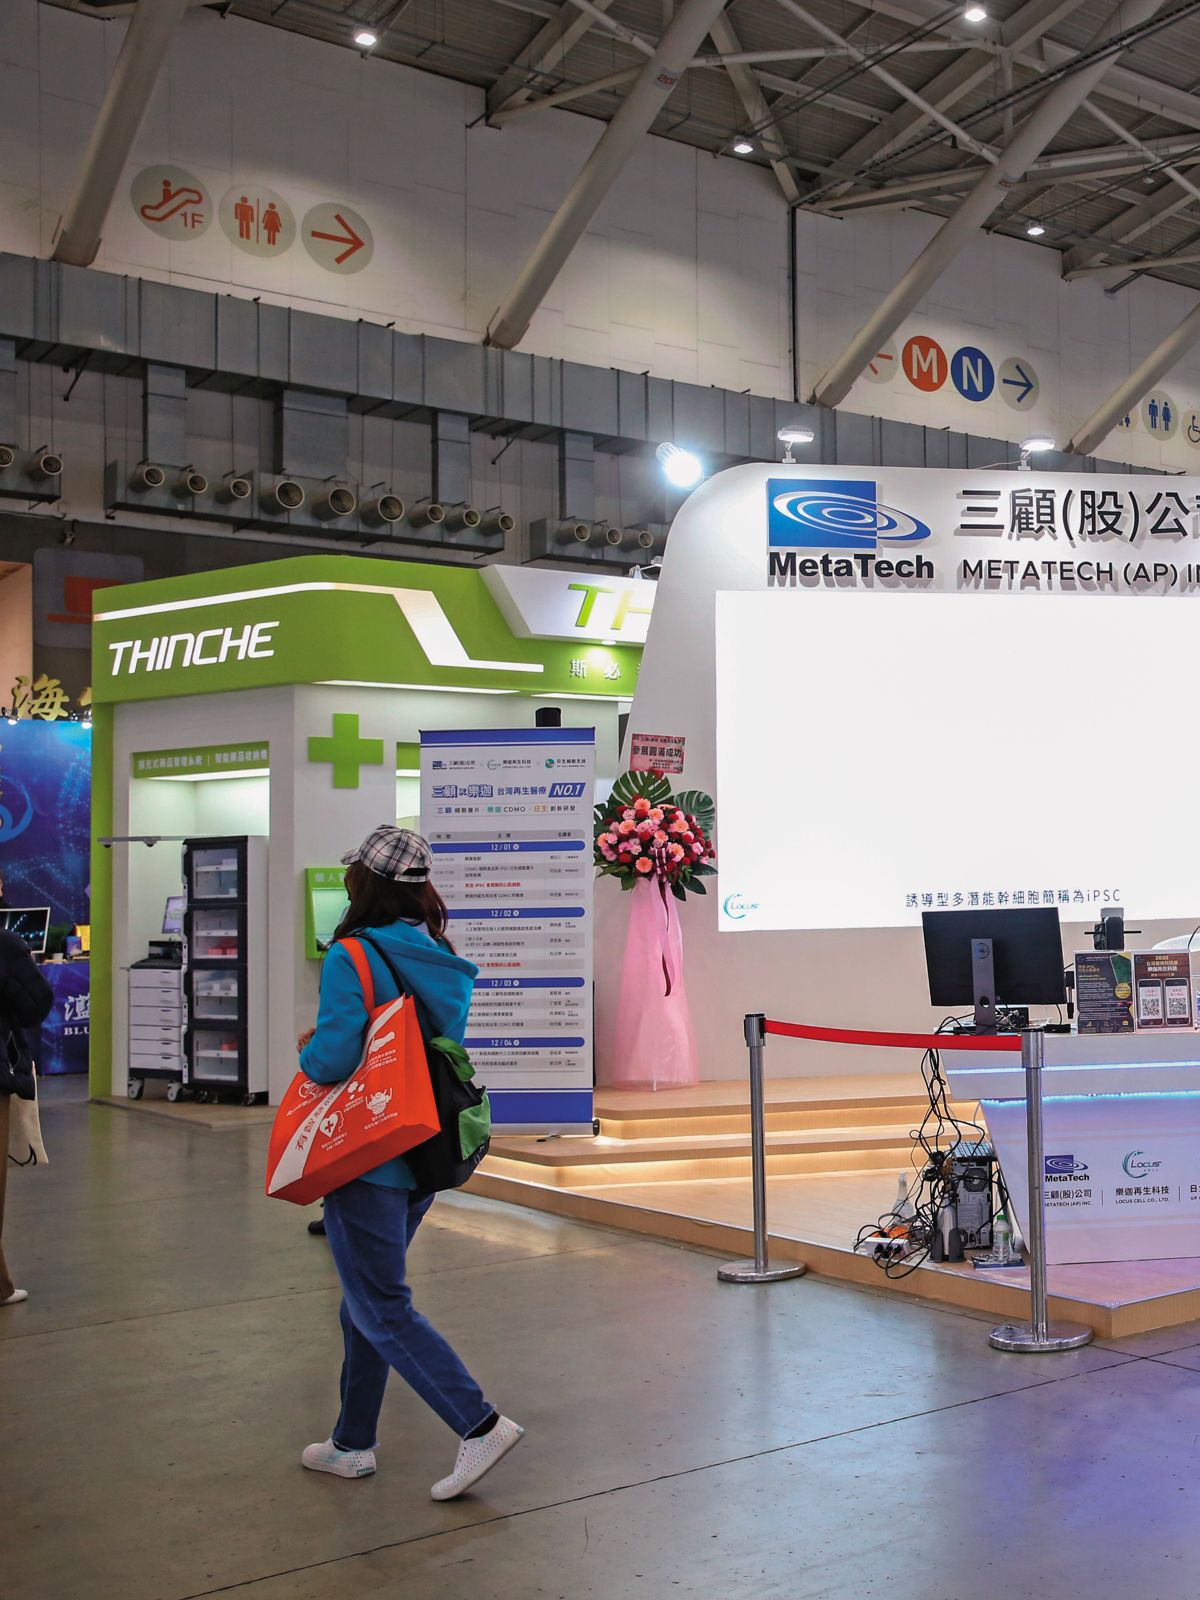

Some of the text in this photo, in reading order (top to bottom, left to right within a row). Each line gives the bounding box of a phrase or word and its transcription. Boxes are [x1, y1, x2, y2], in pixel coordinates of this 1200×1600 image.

[180, 210, 204, 230] 1F
[911, 343, 984, 394] M N
[768, 551, 935, 580] MetaTech
[962, 559, 1112, 582] METATECH
[1123, 560, 1178, 586] (AP)
[108, 620, 280, 676] THINCHE
[553, 783, 582, 796] NO.1
[1045, 1174, 1090, 1182] MetaTech
[1044, 1189, 1092, 1199] 三顧(股)公司
[1115, 1186, 1170, 1196] 樂迦再生科技
